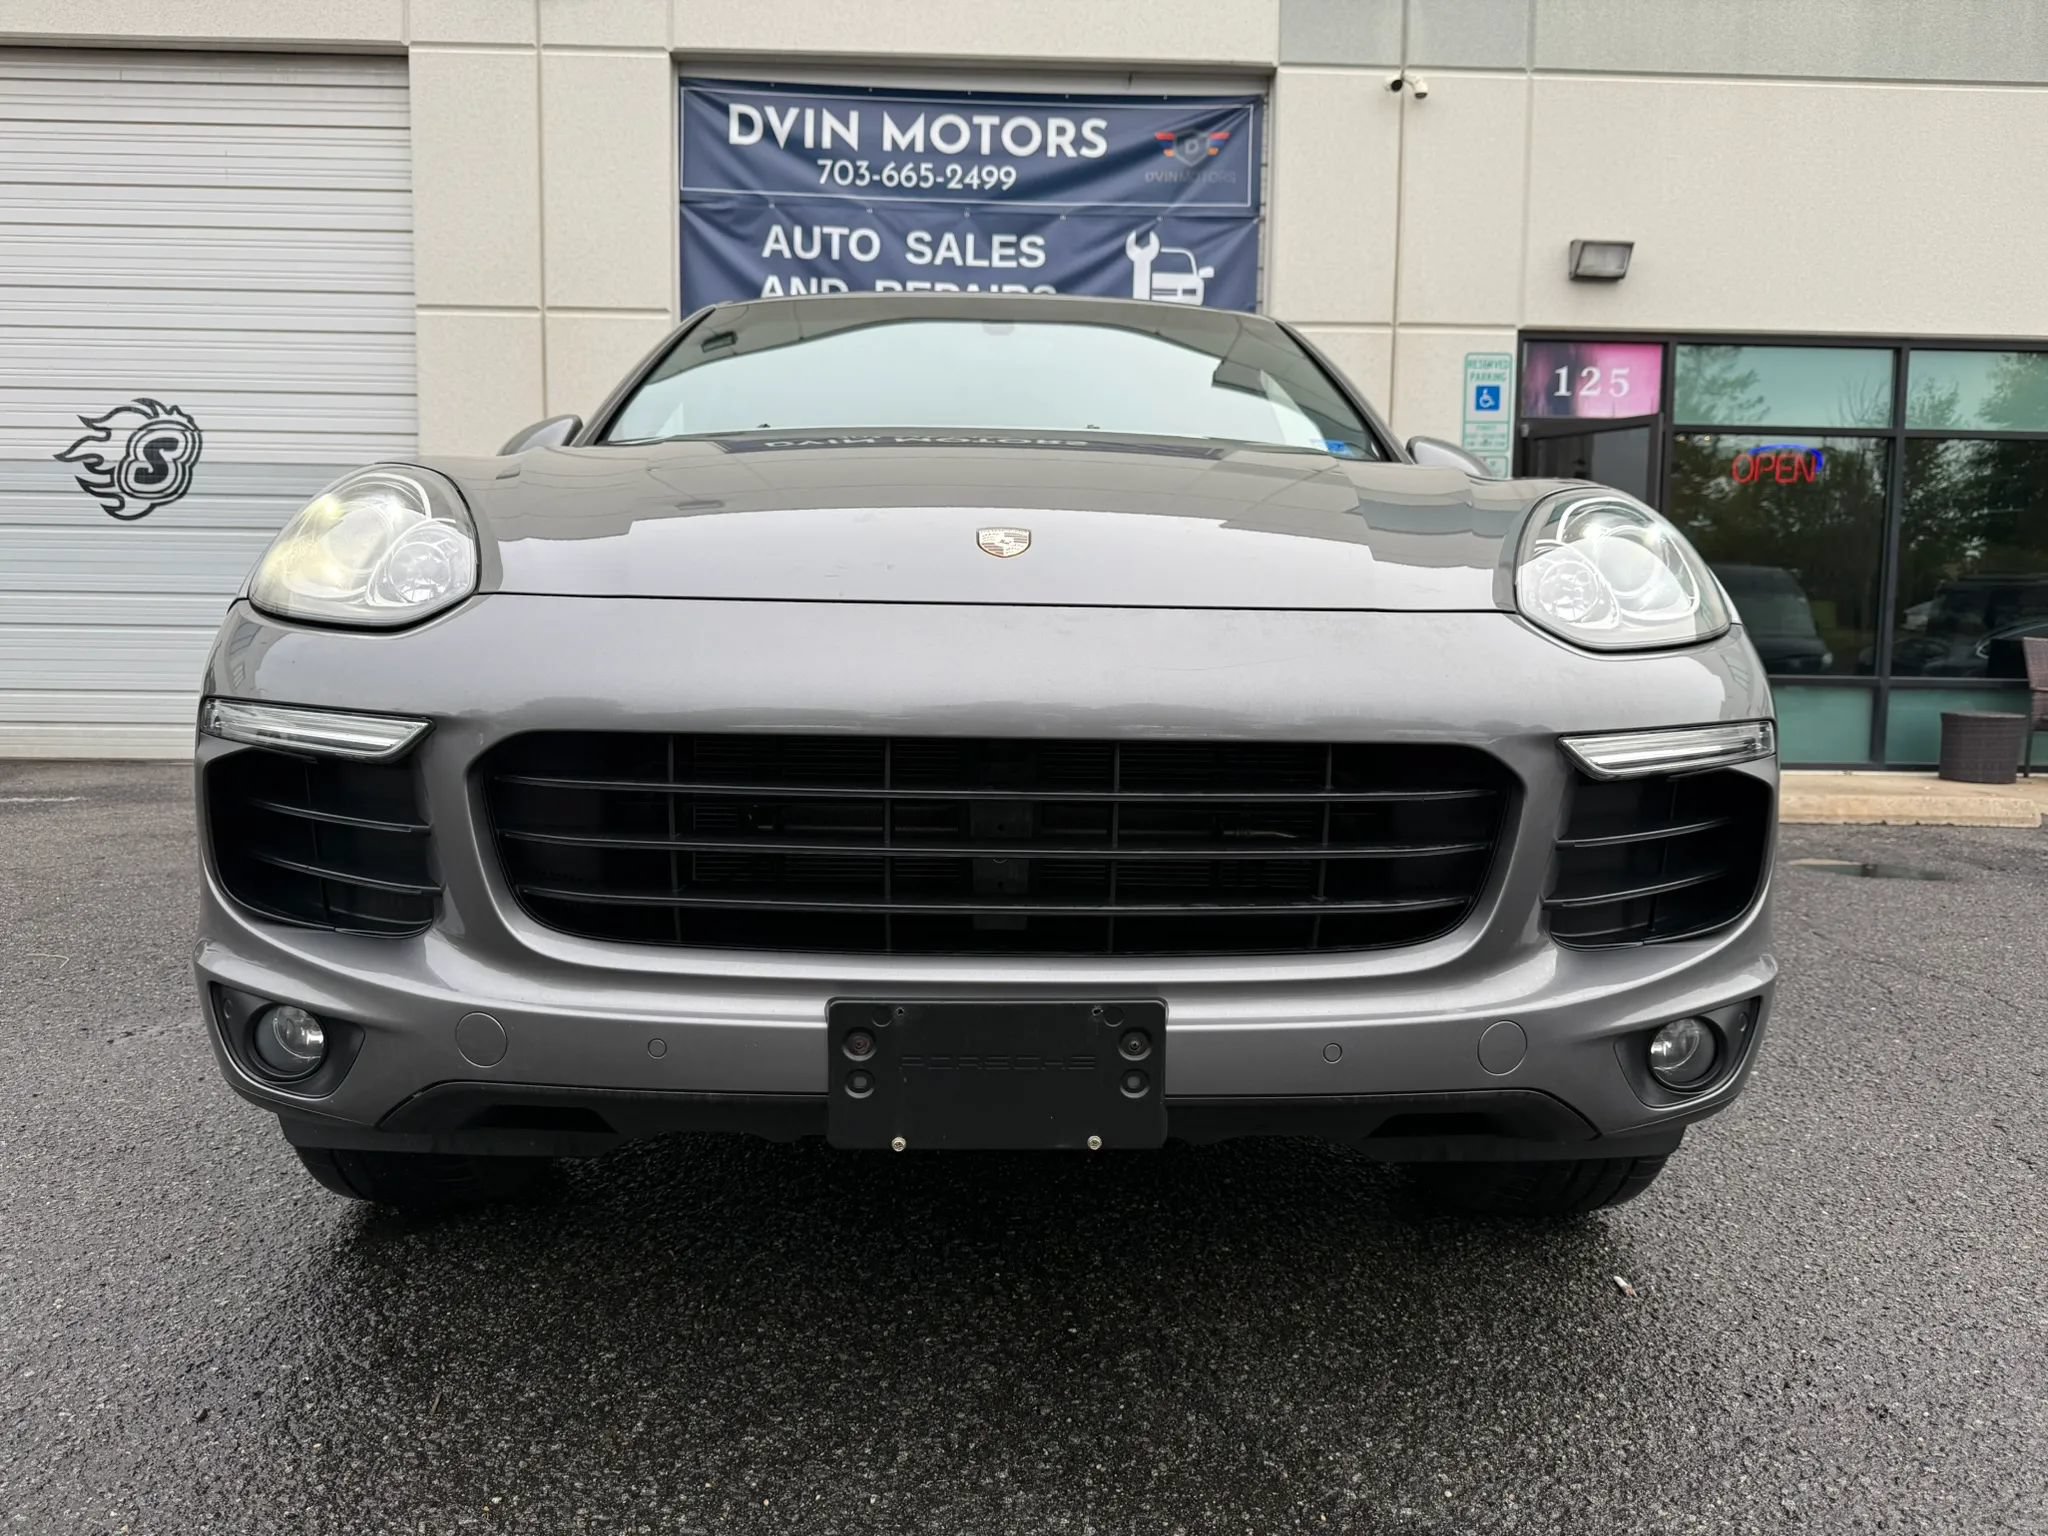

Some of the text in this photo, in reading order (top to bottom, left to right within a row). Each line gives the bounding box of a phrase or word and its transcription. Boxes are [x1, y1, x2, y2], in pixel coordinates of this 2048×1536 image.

[728, 103, 1108, 159] DVIN MOTORS
[817, 159, 1017, 190] 703-665-2499
[761, 224, 1046, 268] AUTO SALES
[1553, 365, 1631, 398] 125
[1732, 452, 1816, 484] OPEN
